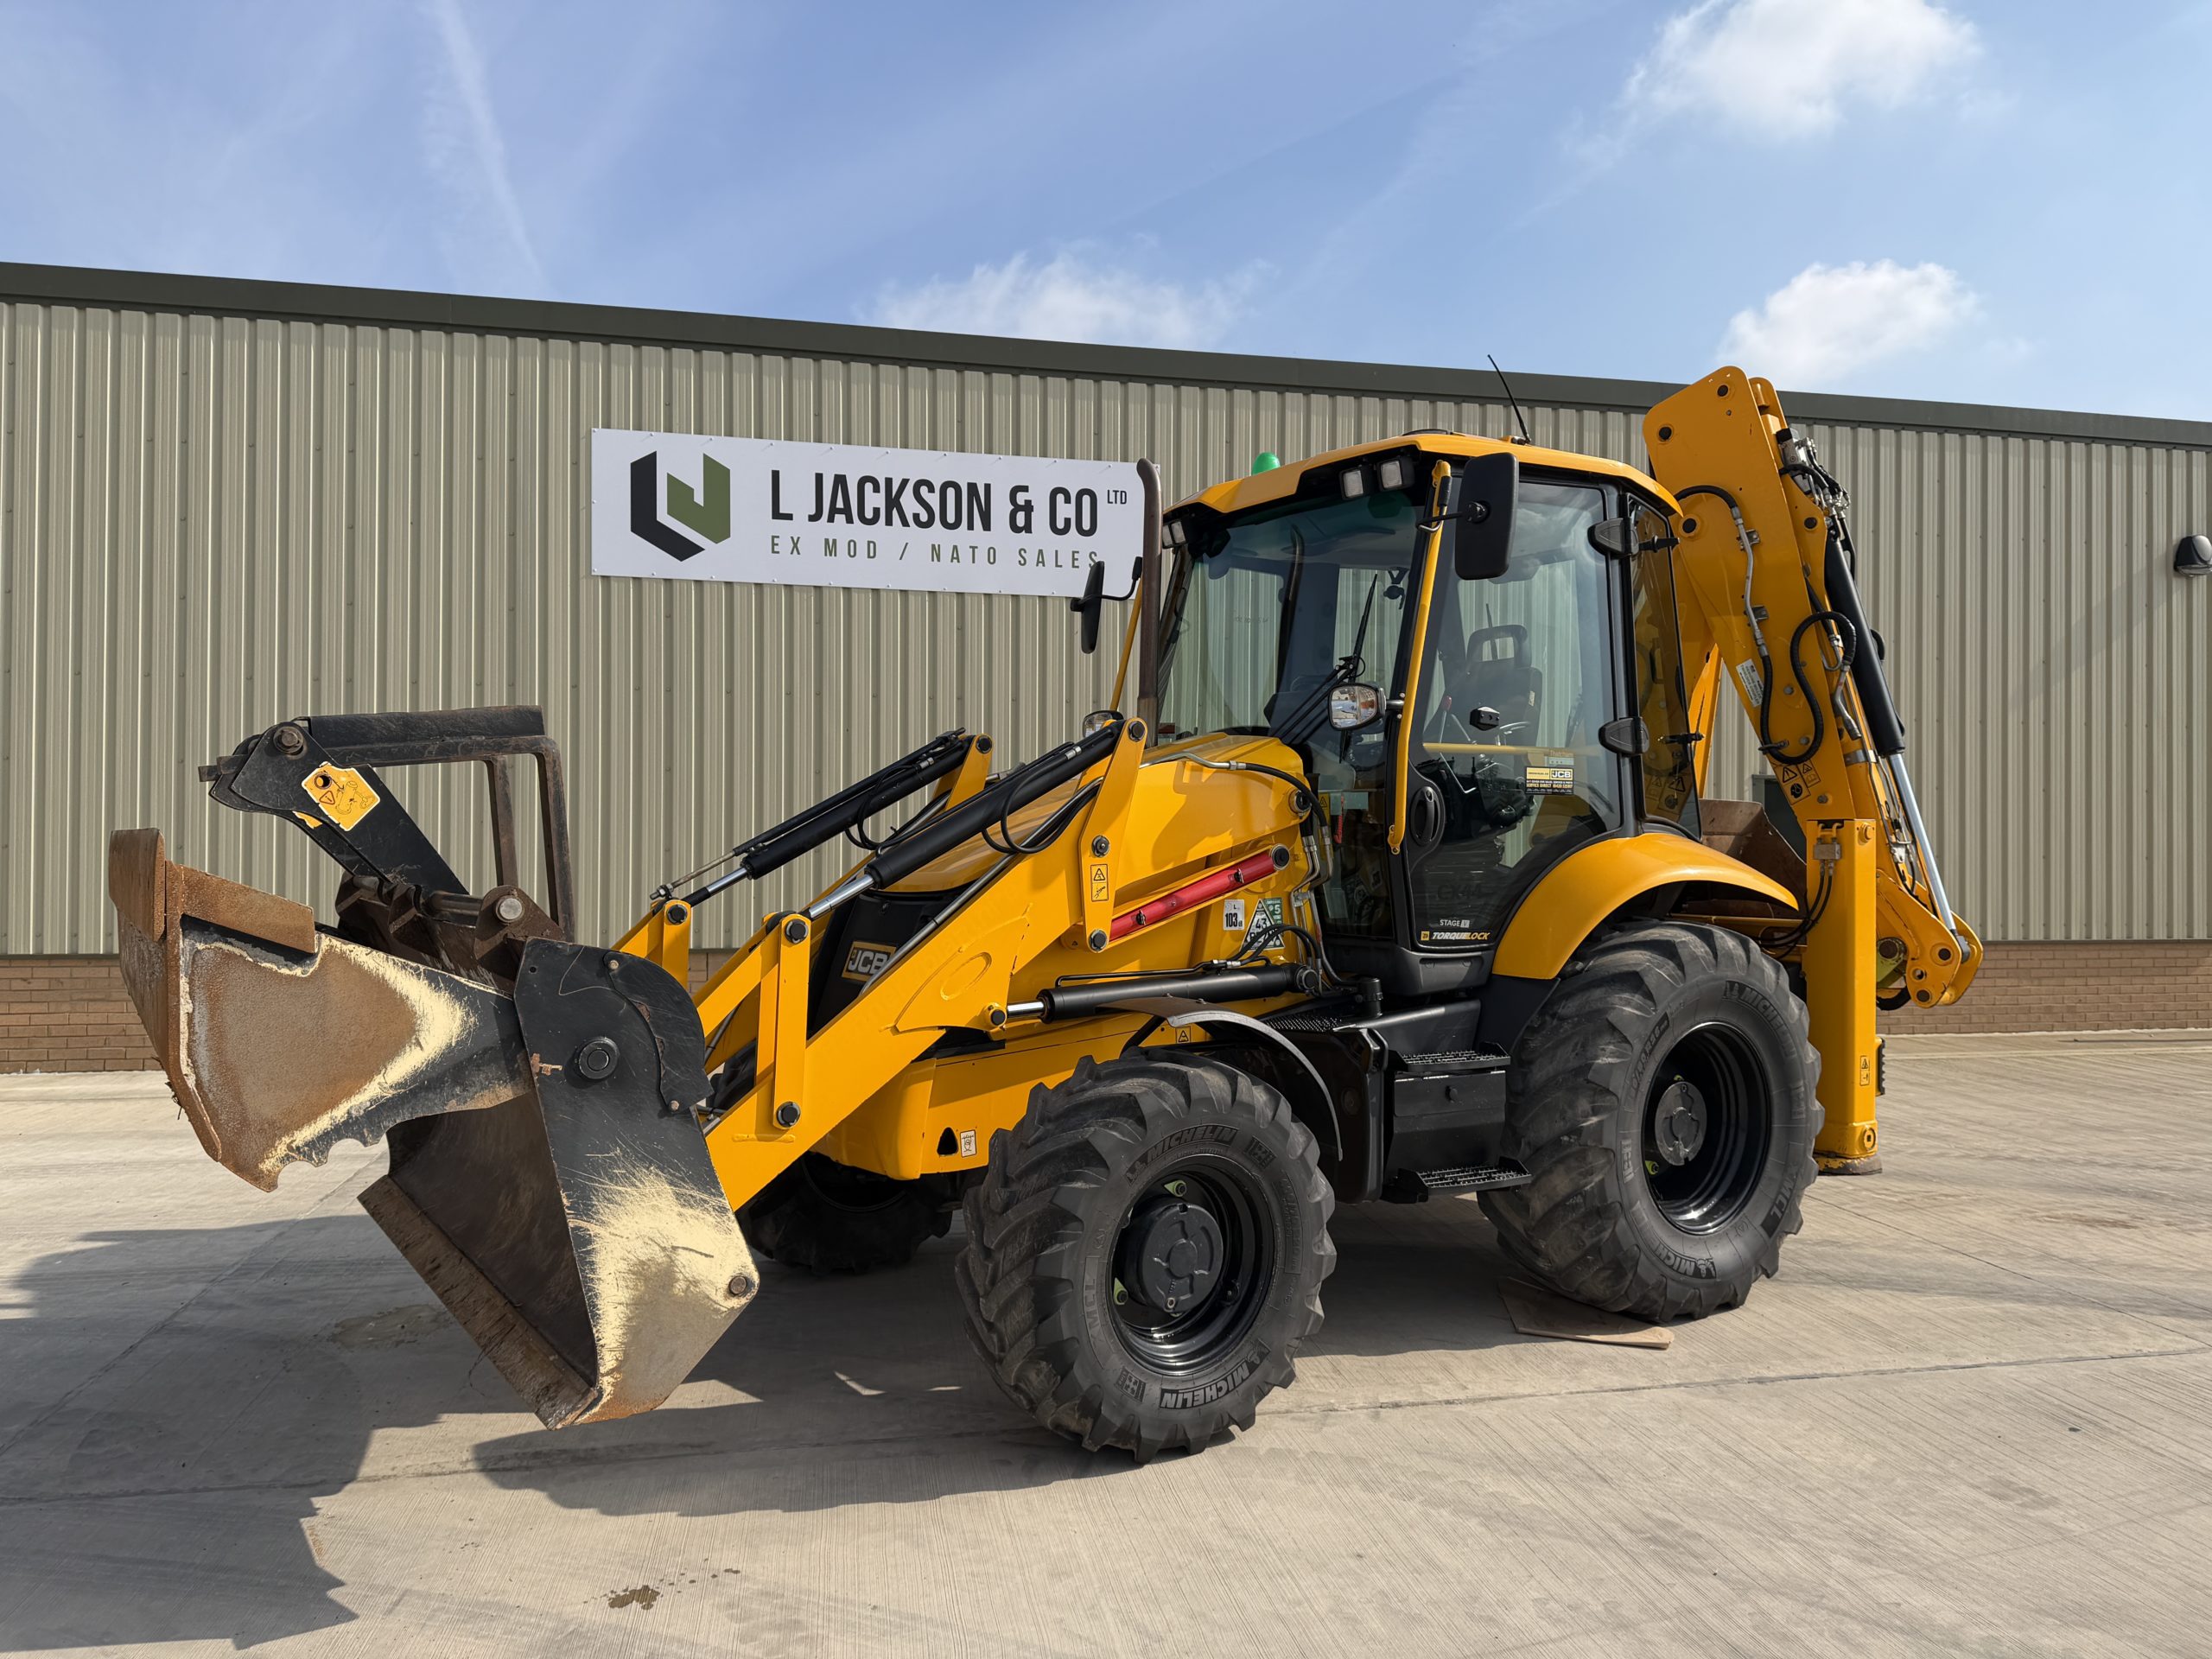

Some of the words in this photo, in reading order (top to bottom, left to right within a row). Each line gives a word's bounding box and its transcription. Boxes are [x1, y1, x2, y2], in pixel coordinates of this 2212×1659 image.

[772, 469, 793, 521] L
[808, 472, 991, 531] JACKSON
[1008, 485, 1034, 534] &
[1049, 486, 1097, 537] CO
[1107, 489, 1127, 504] LTD
[771, 535, 801, 556] EX
[823, 537, 877, 559] MOD
[899, 542, 909, 561] /
[931, 543, 996, 565] NATO
[1018, 548, 1098, 569] SALES
[1224, 912, 1238, 927] 103
[848, 950, 888, 975] JCB
[1147, 1126, 1236, 1163] MICHELIN
[1160, 1361, 1250, 1408] MICHELIN
